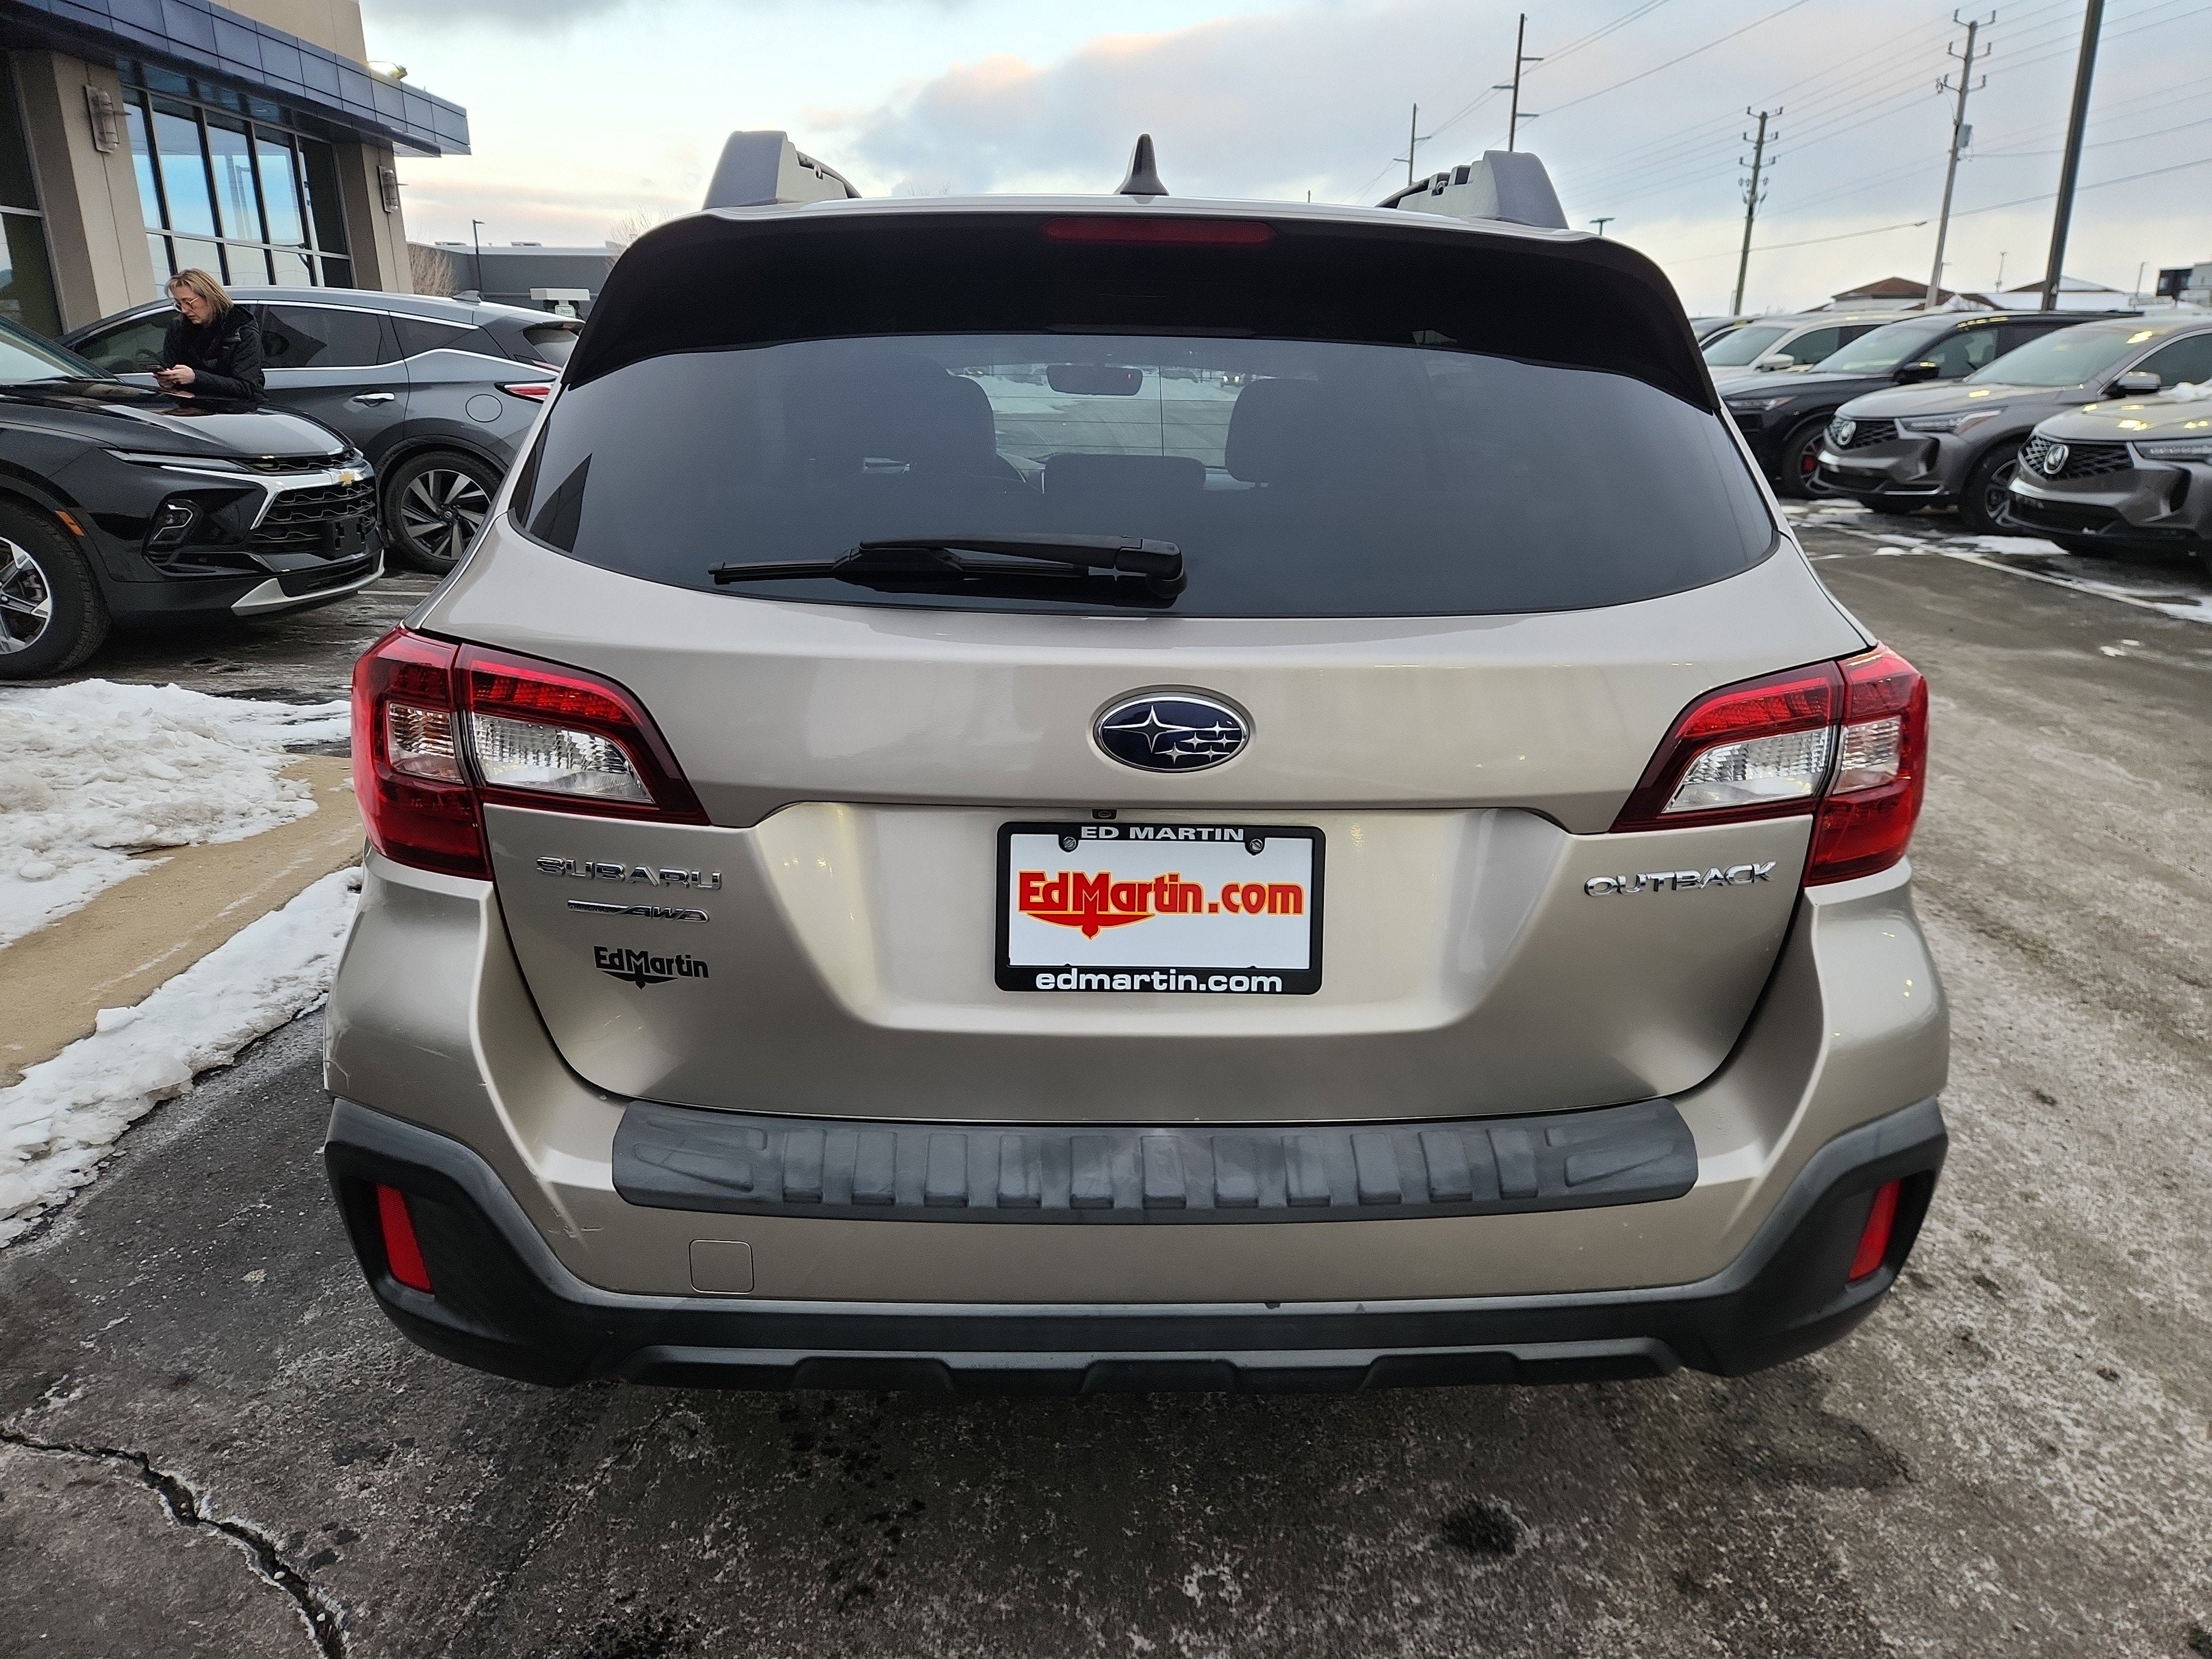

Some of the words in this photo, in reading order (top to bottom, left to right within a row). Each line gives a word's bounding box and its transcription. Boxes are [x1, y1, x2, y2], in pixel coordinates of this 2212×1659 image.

[1081, 826, 1119, 839] ED
[1129, 827, 1244, 841] MARTIN
[536, 856, 722, 890] SUBARU
[1584, 860, 1777, 897] OUTBACK
[1017, 870, 1304, 915] EdMartin.com
[623, 905, 710, 922] AWD
[593, 945, 709, 979] EdMartin
[1035, 968, 1283, 993] edmartin.com
